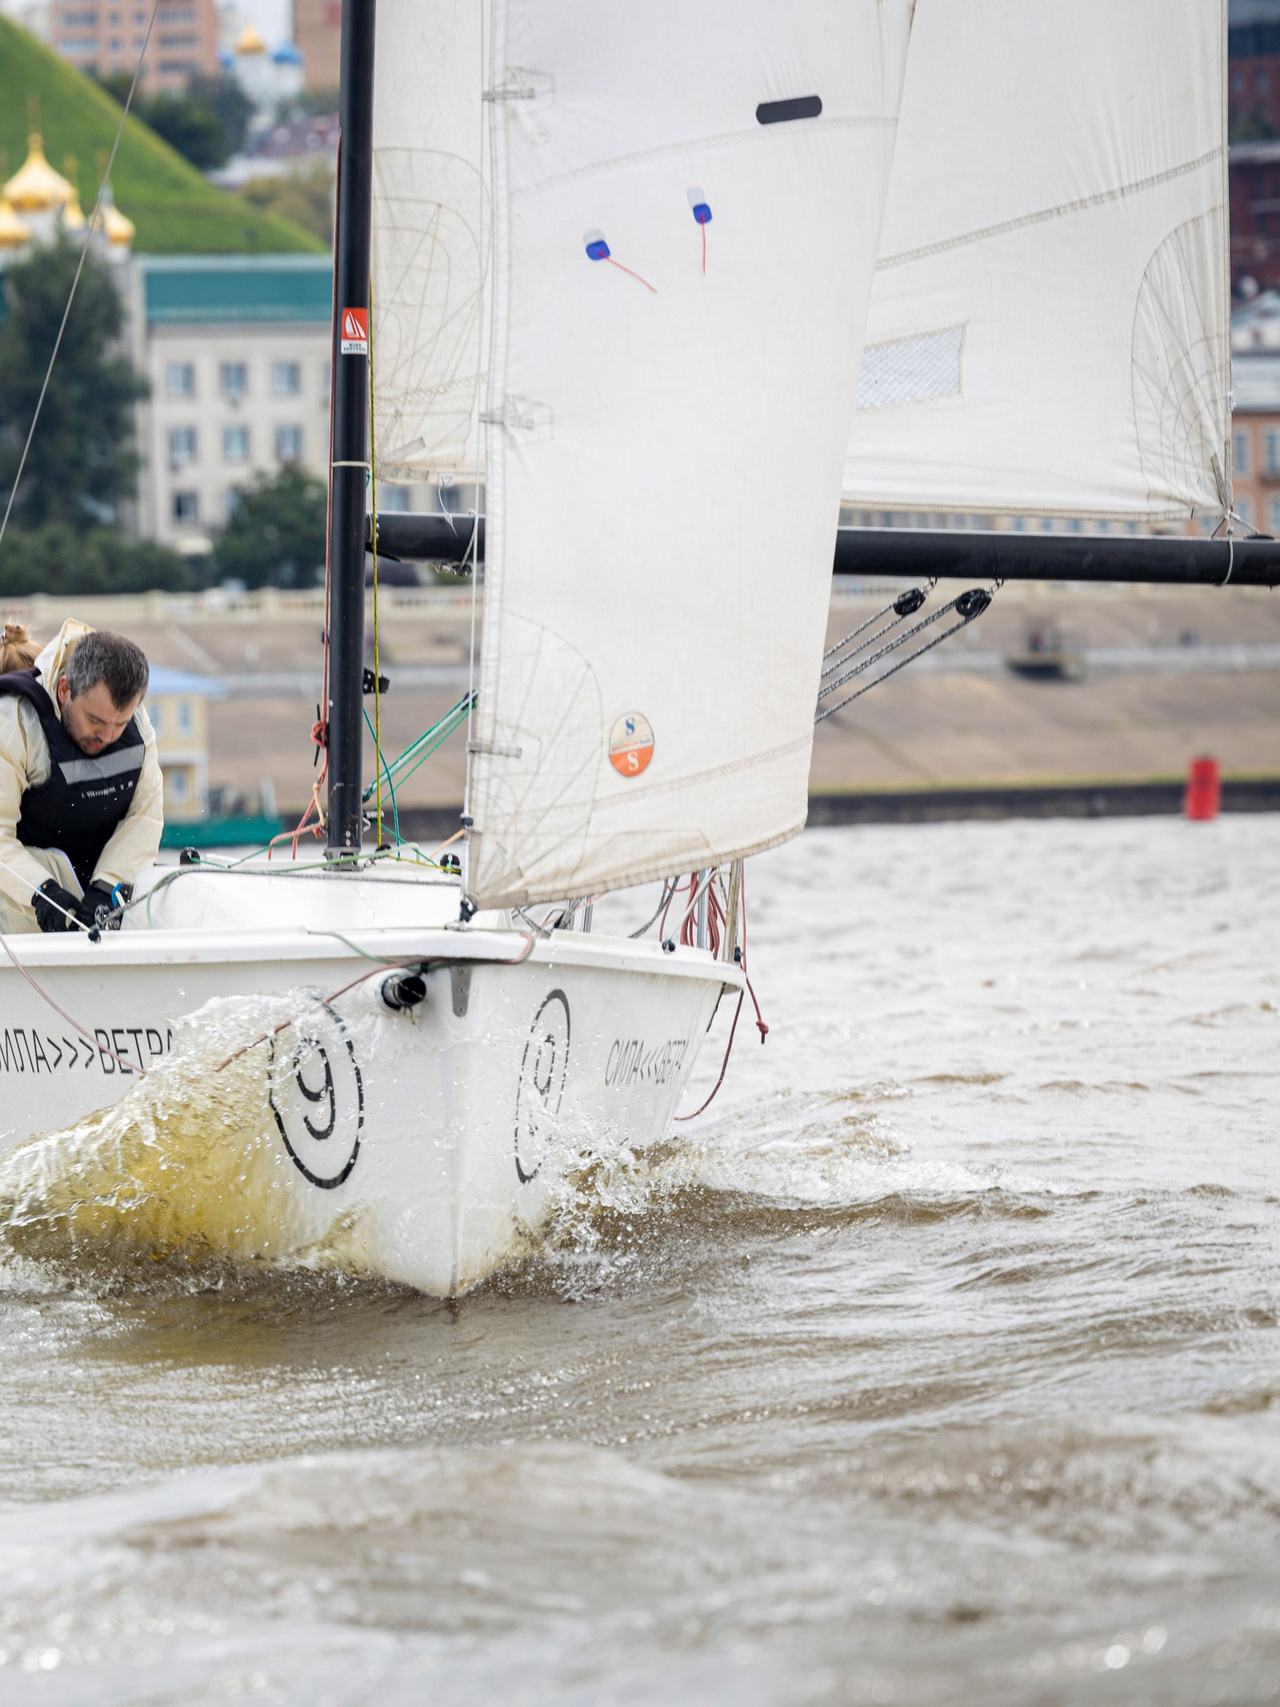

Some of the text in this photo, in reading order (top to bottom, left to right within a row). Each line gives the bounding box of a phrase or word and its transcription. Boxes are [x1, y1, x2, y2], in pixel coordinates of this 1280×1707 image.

[625, 717, 636, 736] S
[627, 751, 639, 771] S
[293, 1036, 336, 1140] 9
